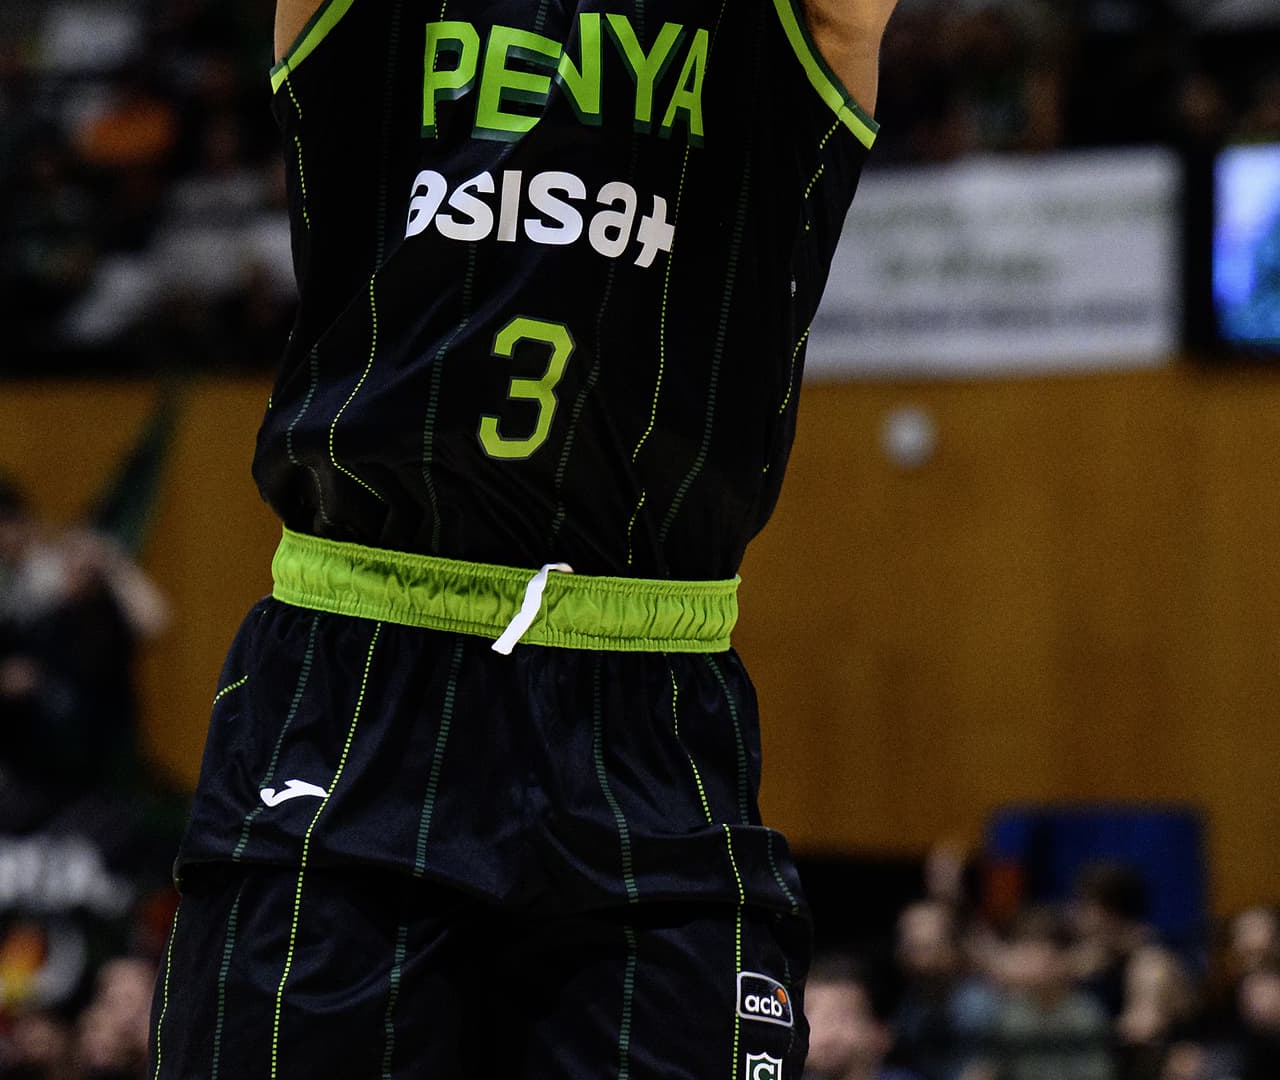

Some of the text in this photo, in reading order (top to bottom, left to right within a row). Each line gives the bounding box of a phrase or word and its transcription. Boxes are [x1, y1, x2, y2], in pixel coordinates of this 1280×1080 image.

[421, 12, 710, 144] PENYA
[476, 316, 577, 461] 3
[744, 994, 783, 1017] acb
